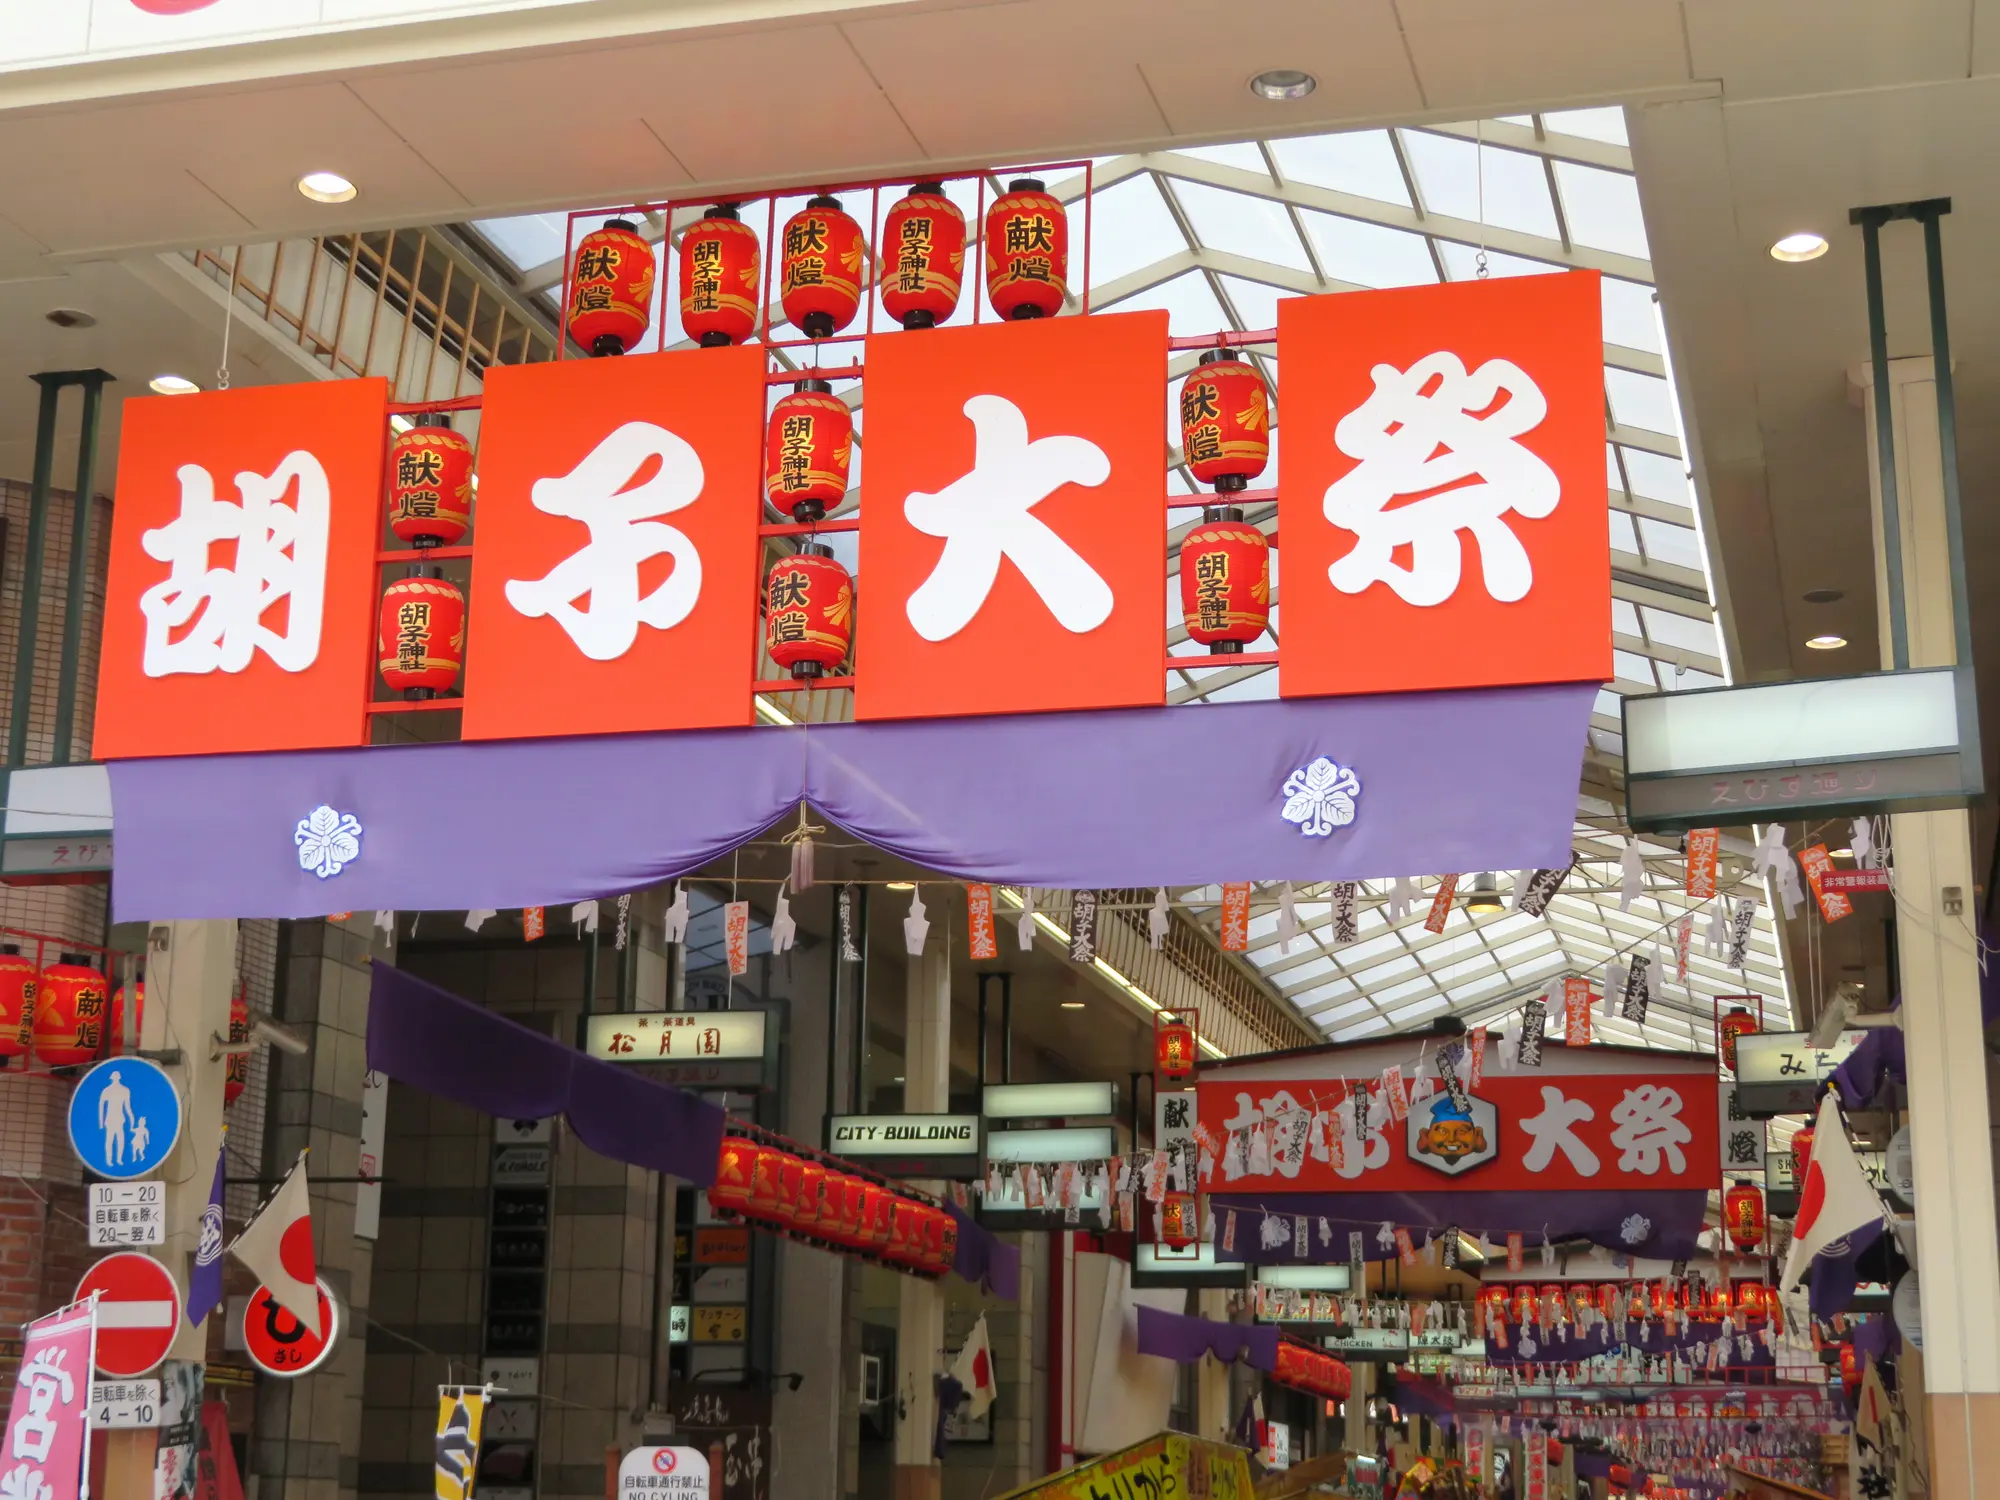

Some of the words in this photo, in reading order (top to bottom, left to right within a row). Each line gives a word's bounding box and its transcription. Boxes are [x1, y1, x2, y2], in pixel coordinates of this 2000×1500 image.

[692, 240, 723, 311] 胡子神社
[899, 217, 934, 294] 胡子神社
[782, 416, 814, 492] 胡子神社
[1197, 551, 1231, 630] 胡子神社
[398, 603, 430, 671] 胡子神社
[1710, 769, 1878, 804] えびす通り
[1691, 834, 1716, 897] 胡子大祭
[970, 900, 993, 958] 胡子大祭
[1069, 902, 1096, 962] 胡子大祭
[1224, 890, 1247, 949] 胡子大祭
[1333, 882, 1357, 943] 胡子大祭
[1729, 910, 1753, 968] 胡子大祭
[727, 916, 747, 974] 胡子大祭
[608, 1028, 720, 1056] 松月園
[1519, 1013, 1544, 1065] 胡子大祭
[1566, 991, 1589, 1044] 胡子大祭
[836, 1125, 971, 1140] CITY-BUILDING
[1519, 1084, 1692, 1177] 大祭
[96, 1208, 159, 1225] 自転車を除く
[1334, 1340, 1373, 1348] CHICKEN
[92, 1386, 156, 1402] 自転車を除く
[624, 1475, 703, 1489] 自転車通行禁止
